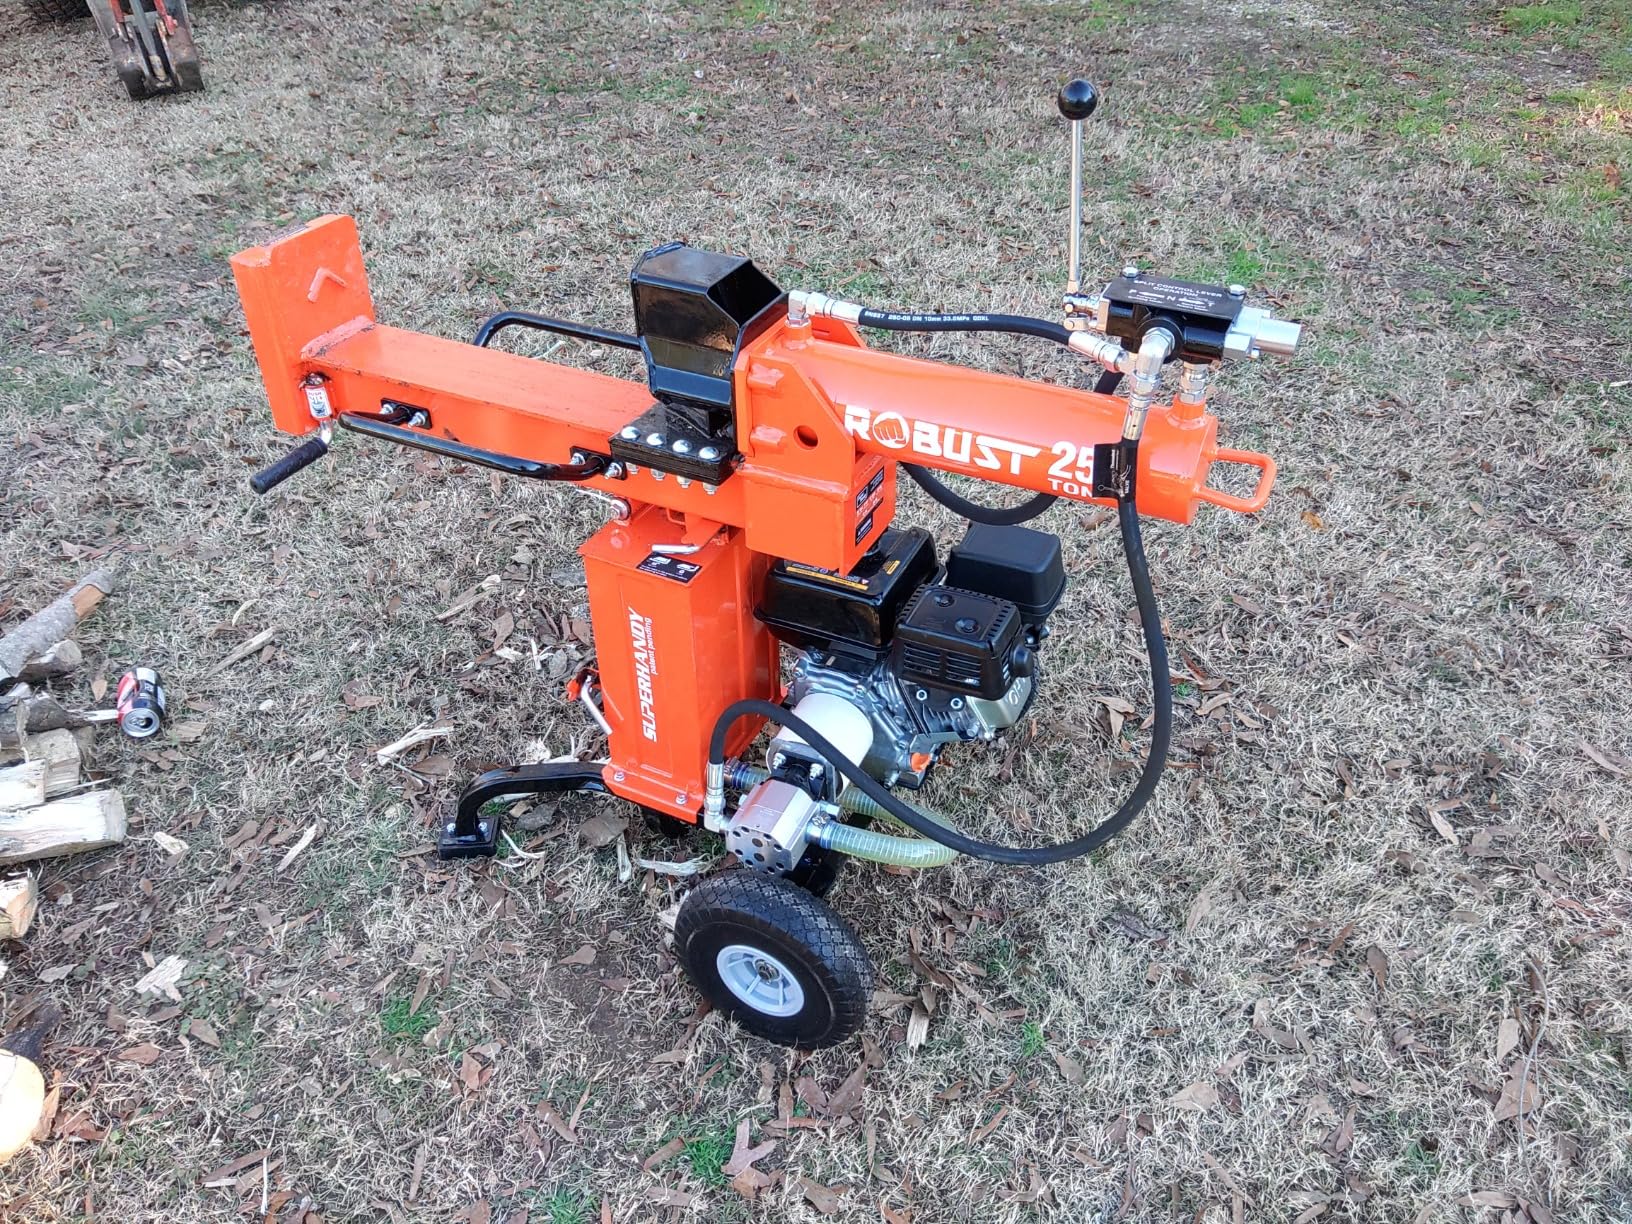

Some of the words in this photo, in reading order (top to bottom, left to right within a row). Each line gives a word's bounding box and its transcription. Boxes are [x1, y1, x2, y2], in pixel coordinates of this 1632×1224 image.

[1152, 286, 1199, 297] OPERATION
[1156, 283, 1195, 293] CONTROL
[1196, 289, 1223, 298] LEVER
[844, 403, 1043, 476] ROBUST
[1048, 441, 1095, 484] 25
[644, 617, 656, 650] pending
[628, 606, 657, 743] SUPERHANDY
[647, 649, 658, 676] patent
